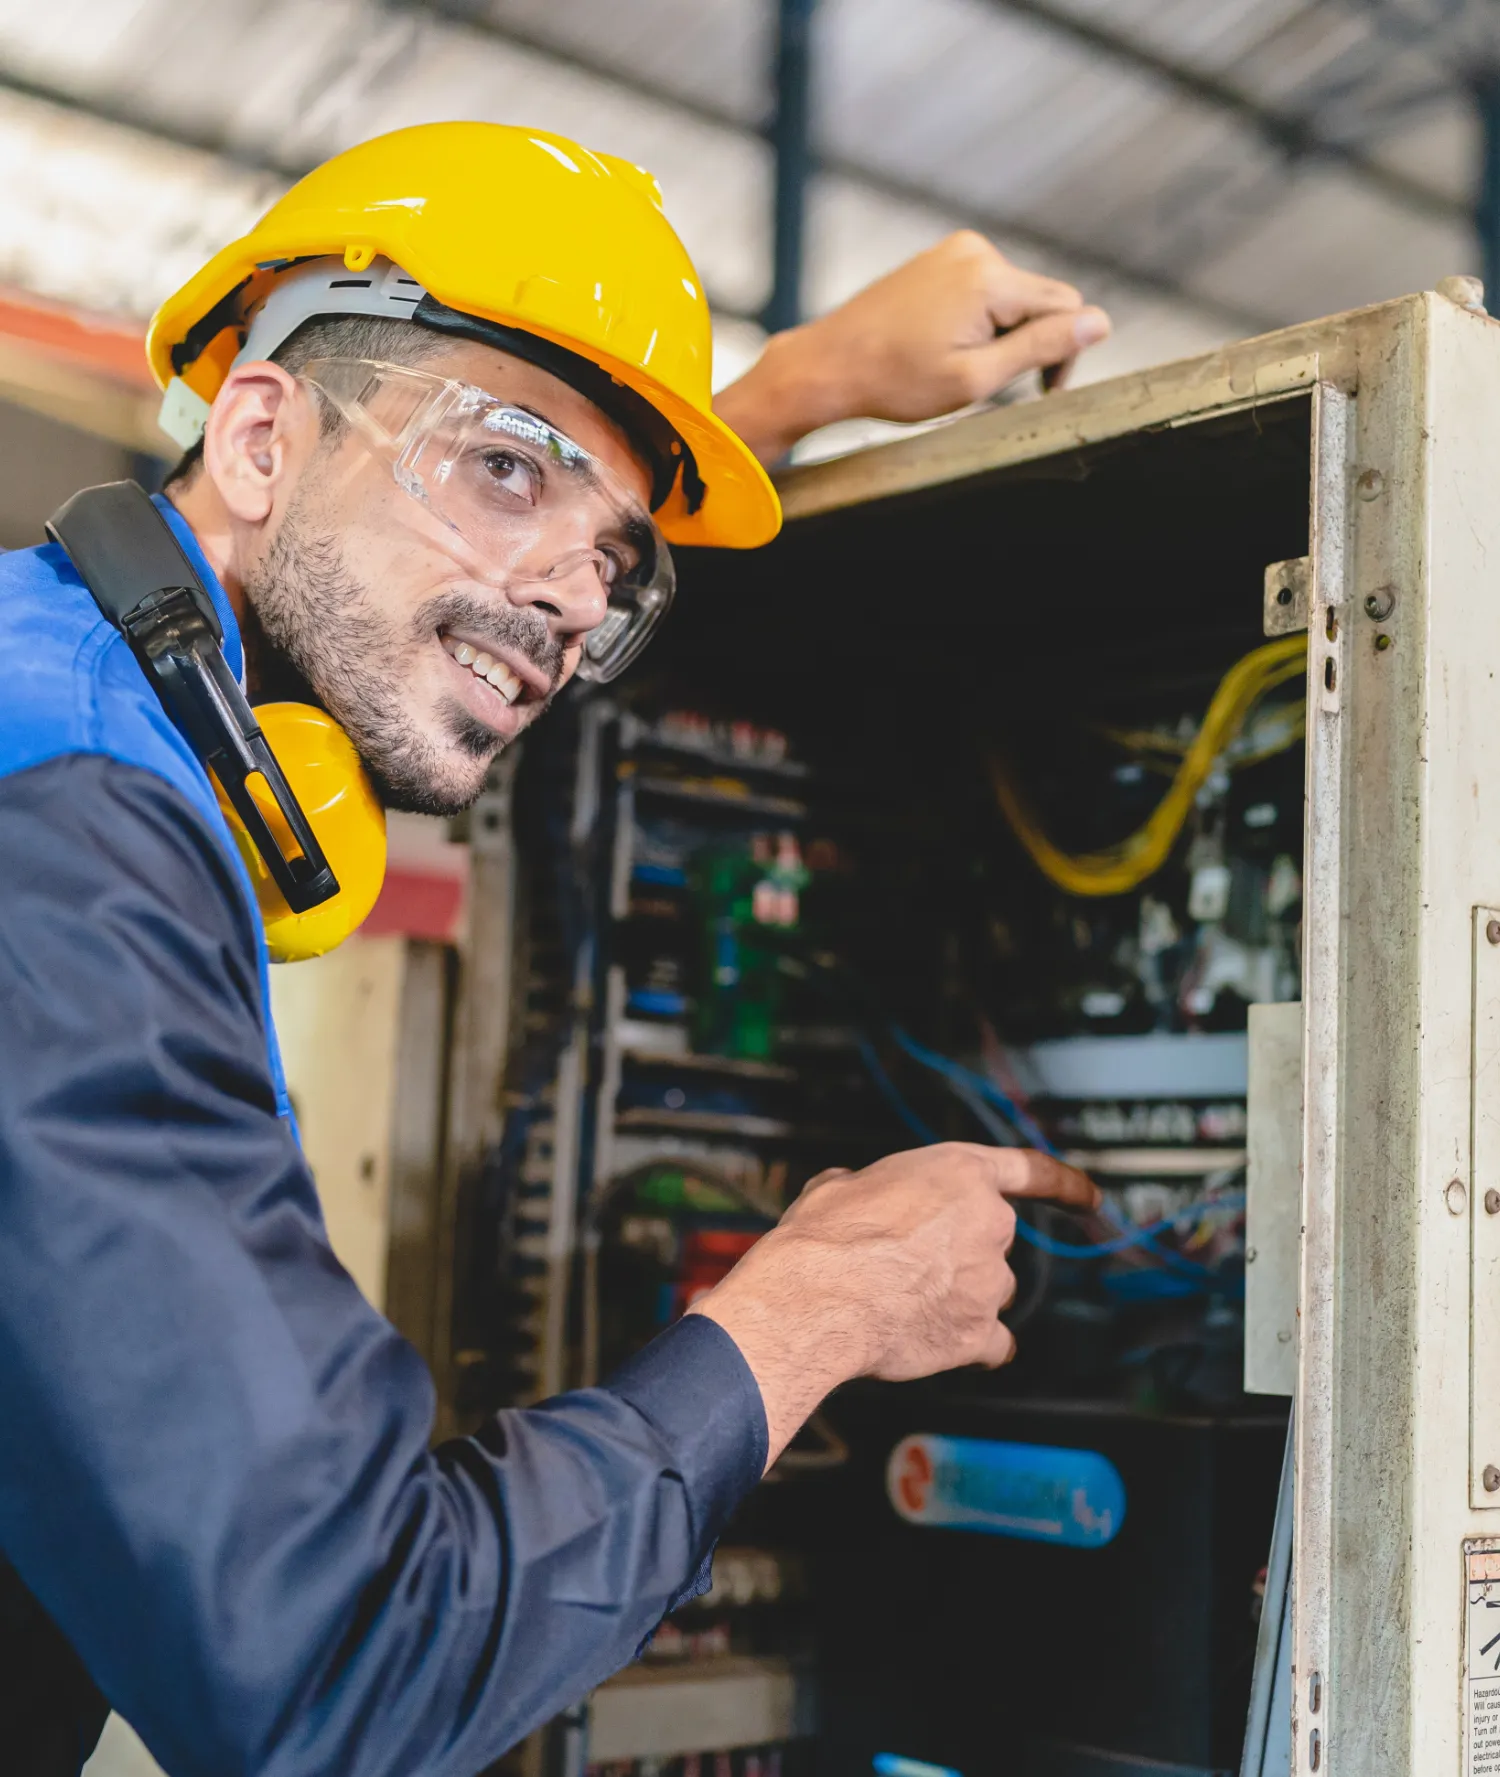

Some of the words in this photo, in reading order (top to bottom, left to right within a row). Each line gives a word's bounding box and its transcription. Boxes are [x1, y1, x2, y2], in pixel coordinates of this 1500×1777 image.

[1473, 1701, 1485, 1711] Will
[1473, 1715, 1490, 1725] injury
[1492, 1714, 1498, 1722] or
[1474, 1727, 1487, 1737] Turn
[1490, 1725, 1498, 1735] off
[1473, 1740, 1483, 1749] out
[1473, 1765, 1492, 1775] before
